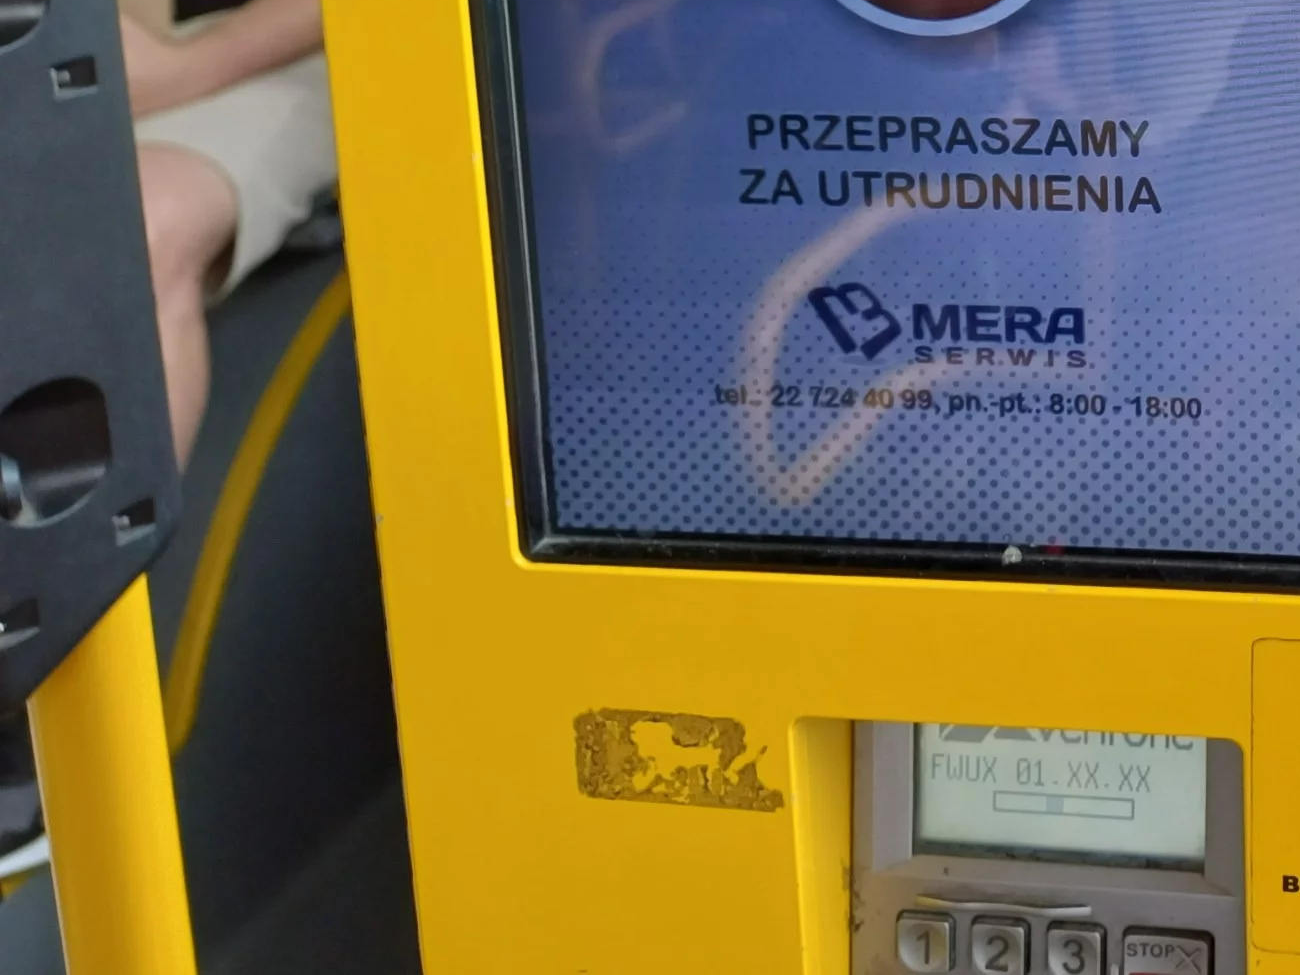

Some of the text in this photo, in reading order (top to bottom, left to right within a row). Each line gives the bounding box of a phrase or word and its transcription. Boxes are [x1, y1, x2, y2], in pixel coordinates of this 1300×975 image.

[746, 112, 1150, 159] PRZEPRASZAMY
[738, 168, 1163, 215] ZA UTRUDNIENIA
[912, 303, 1085, 345] MERA
[913, 345, 1087, 369] SERWIS
[770, 384, 801, 408] 22
[808, 386, 856, 409] 724
[862, 388, 895, 410] 40
[900, 388, 941, 415] 99,
[1050, 392, 1107, 416] 8:00
[1131, 396, 1202, 419] 18:00
[930, 752, 1152, 793] FWUX 01.XX.XX
[915, 930, 931, 965] 1
[984, 935, 1010, 973] 2
[1062, 939, 1086, 975] 3
[1126, 941, 1175, 959] STOP
